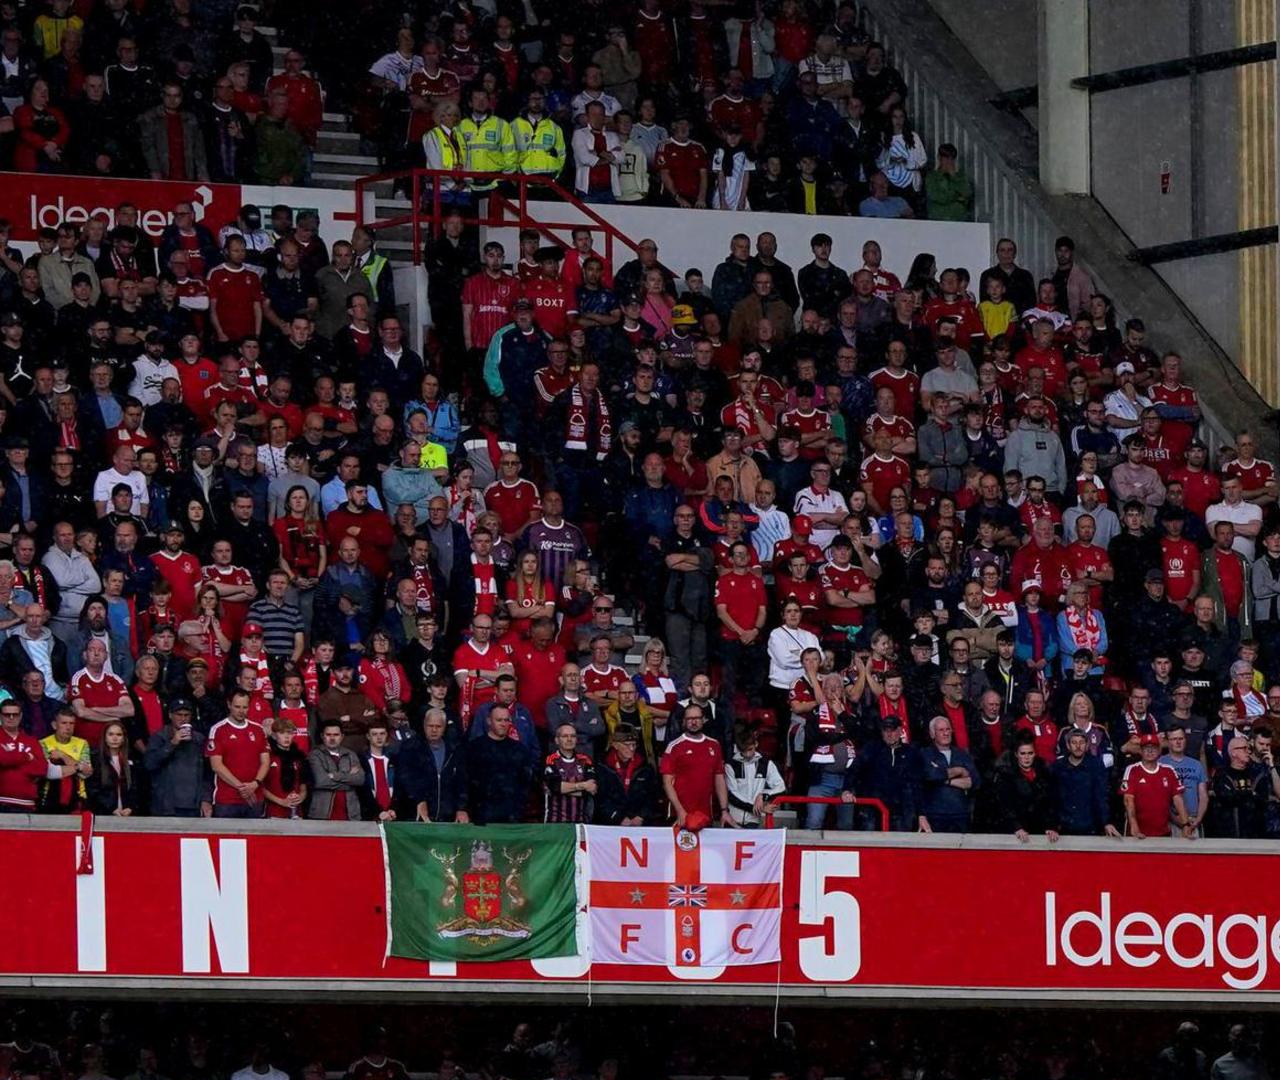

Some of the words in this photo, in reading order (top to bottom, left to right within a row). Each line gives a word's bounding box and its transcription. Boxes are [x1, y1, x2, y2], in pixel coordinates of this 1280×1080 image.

[536, 297, 565, 308] BOXT
[620, 838, 648, 868] N
[732, 841, 756, 871] F
[620, 924, 641, 954] F
[730, 924, 753, 954] C
